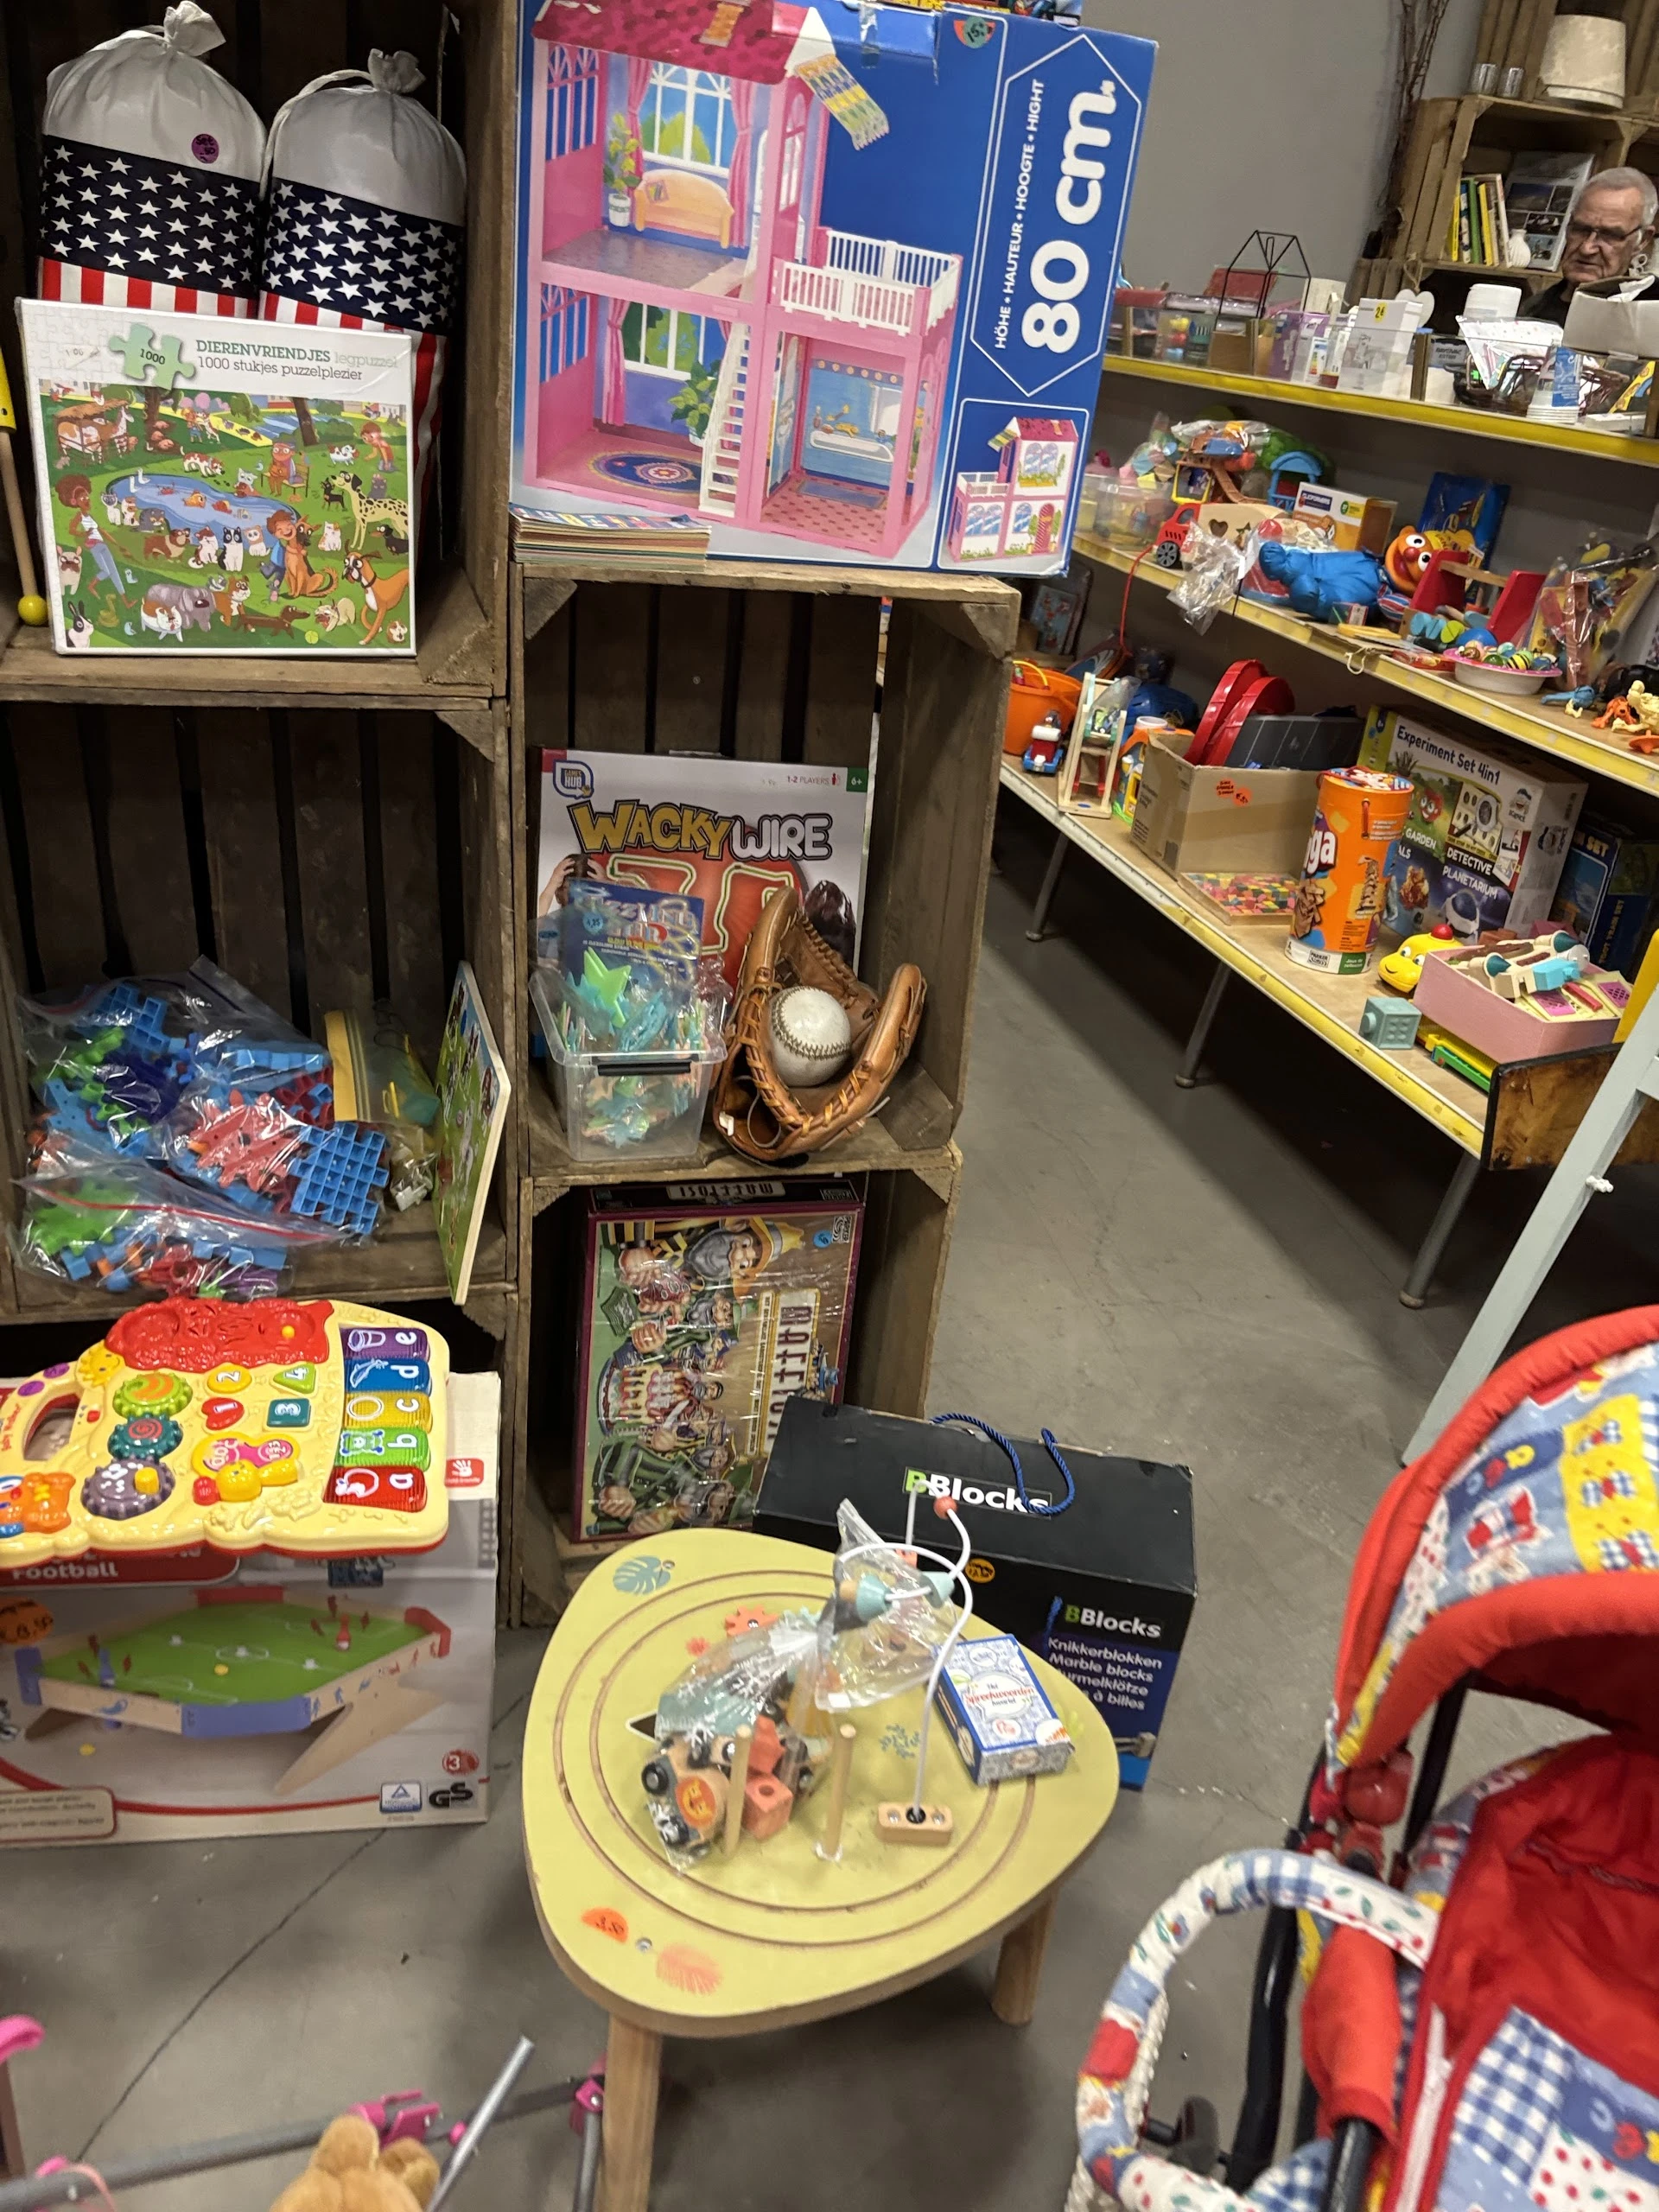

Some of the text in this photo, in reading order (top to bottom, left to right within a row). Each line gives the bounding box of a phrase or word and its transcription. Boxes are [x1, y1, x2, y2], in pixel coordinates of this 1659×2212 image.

[994, 79, 1045, 349] HÖHE HAUTEUR HOOGTE HIGHT
[1021, 91, 1117, 354] 80 cm
[139, 348, 166, 365] 1000
[195, 340, 398, 369] DIERENVRIENDJES legpuzzel
[198, 355, 363, 381] 1000 stukjes puzzelplezier
[1396, 724, 1502, 786] Experiment Set 4in1
[564, 776, 582, 788] HUB
[798, 776, 830, 785] PLAYERS
[851, 776, 863, 786] 6+
[567, 798, 834, 861] WACKY WIRE
[1405, 829, 1438, 850] GARDEN
[1586, 835, 1610, 858] SET
[1446, 846, 1494, 877] DETECTIVE
[1441, 865, 1499, 899] PLANETARIUM
[396, 1332, 416, 1345] e
[216, 1370, 242, 1383] 2
[391, 1364, 419, 1379] d
[274, 1402, 302, 1417] 3
[396, 1397, 420, 1413] c
[387, 1433, 418, 1449] b
[389, 1472, 415, 1490] a
[1065, 1604, 1162, 1639] BBlocks
[1047, 1637, 1163, 1670] Knikkerblokken
[1049, 1652, 1154, 1683] Marble blocks
[1093, 1688, 1146, 1711] à billes
[448, 1755, 461, 1771] 3
[429, 1782, 474, 1809] GS
